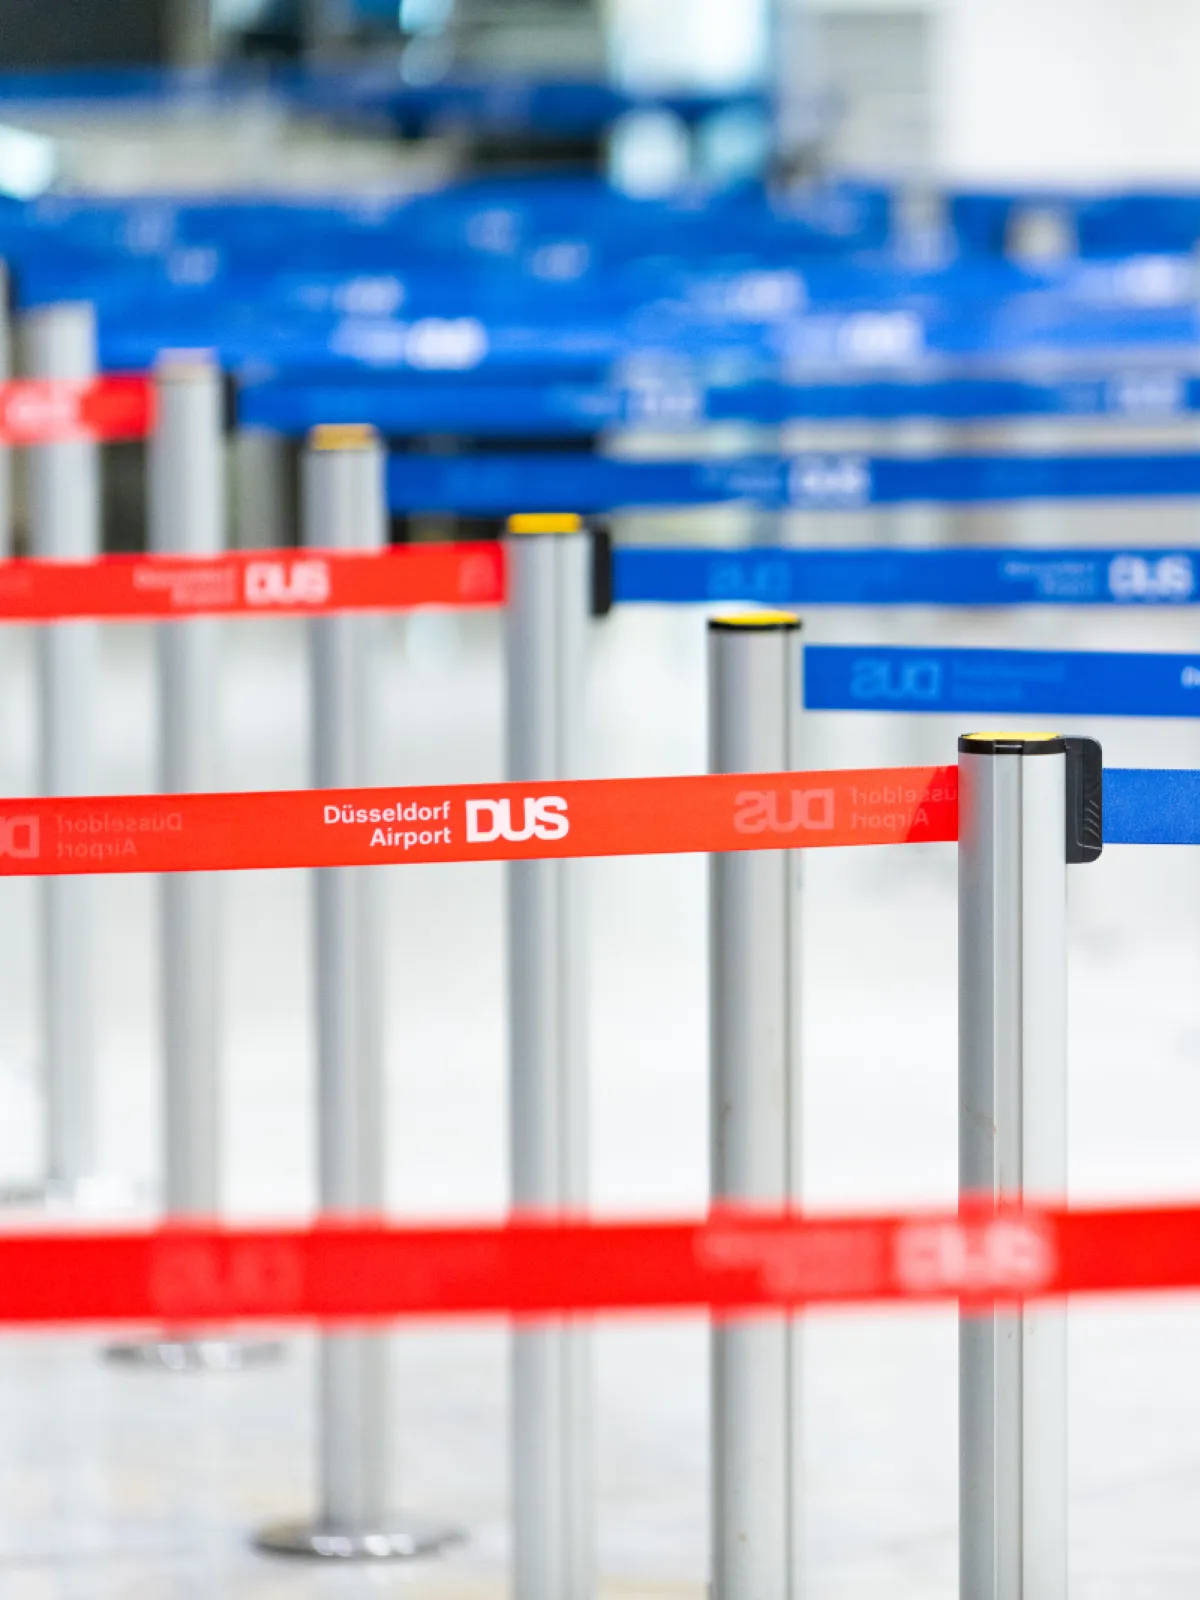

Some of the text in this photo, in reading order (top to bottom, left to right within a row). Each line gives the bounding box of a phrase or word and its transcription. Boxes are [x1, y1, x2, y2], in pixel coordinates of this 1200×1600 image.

[323, 802, 451, 825] Düsseldorf
[466, 796, 569, 843] DUS
[370, 826, 451, 849] Airport
